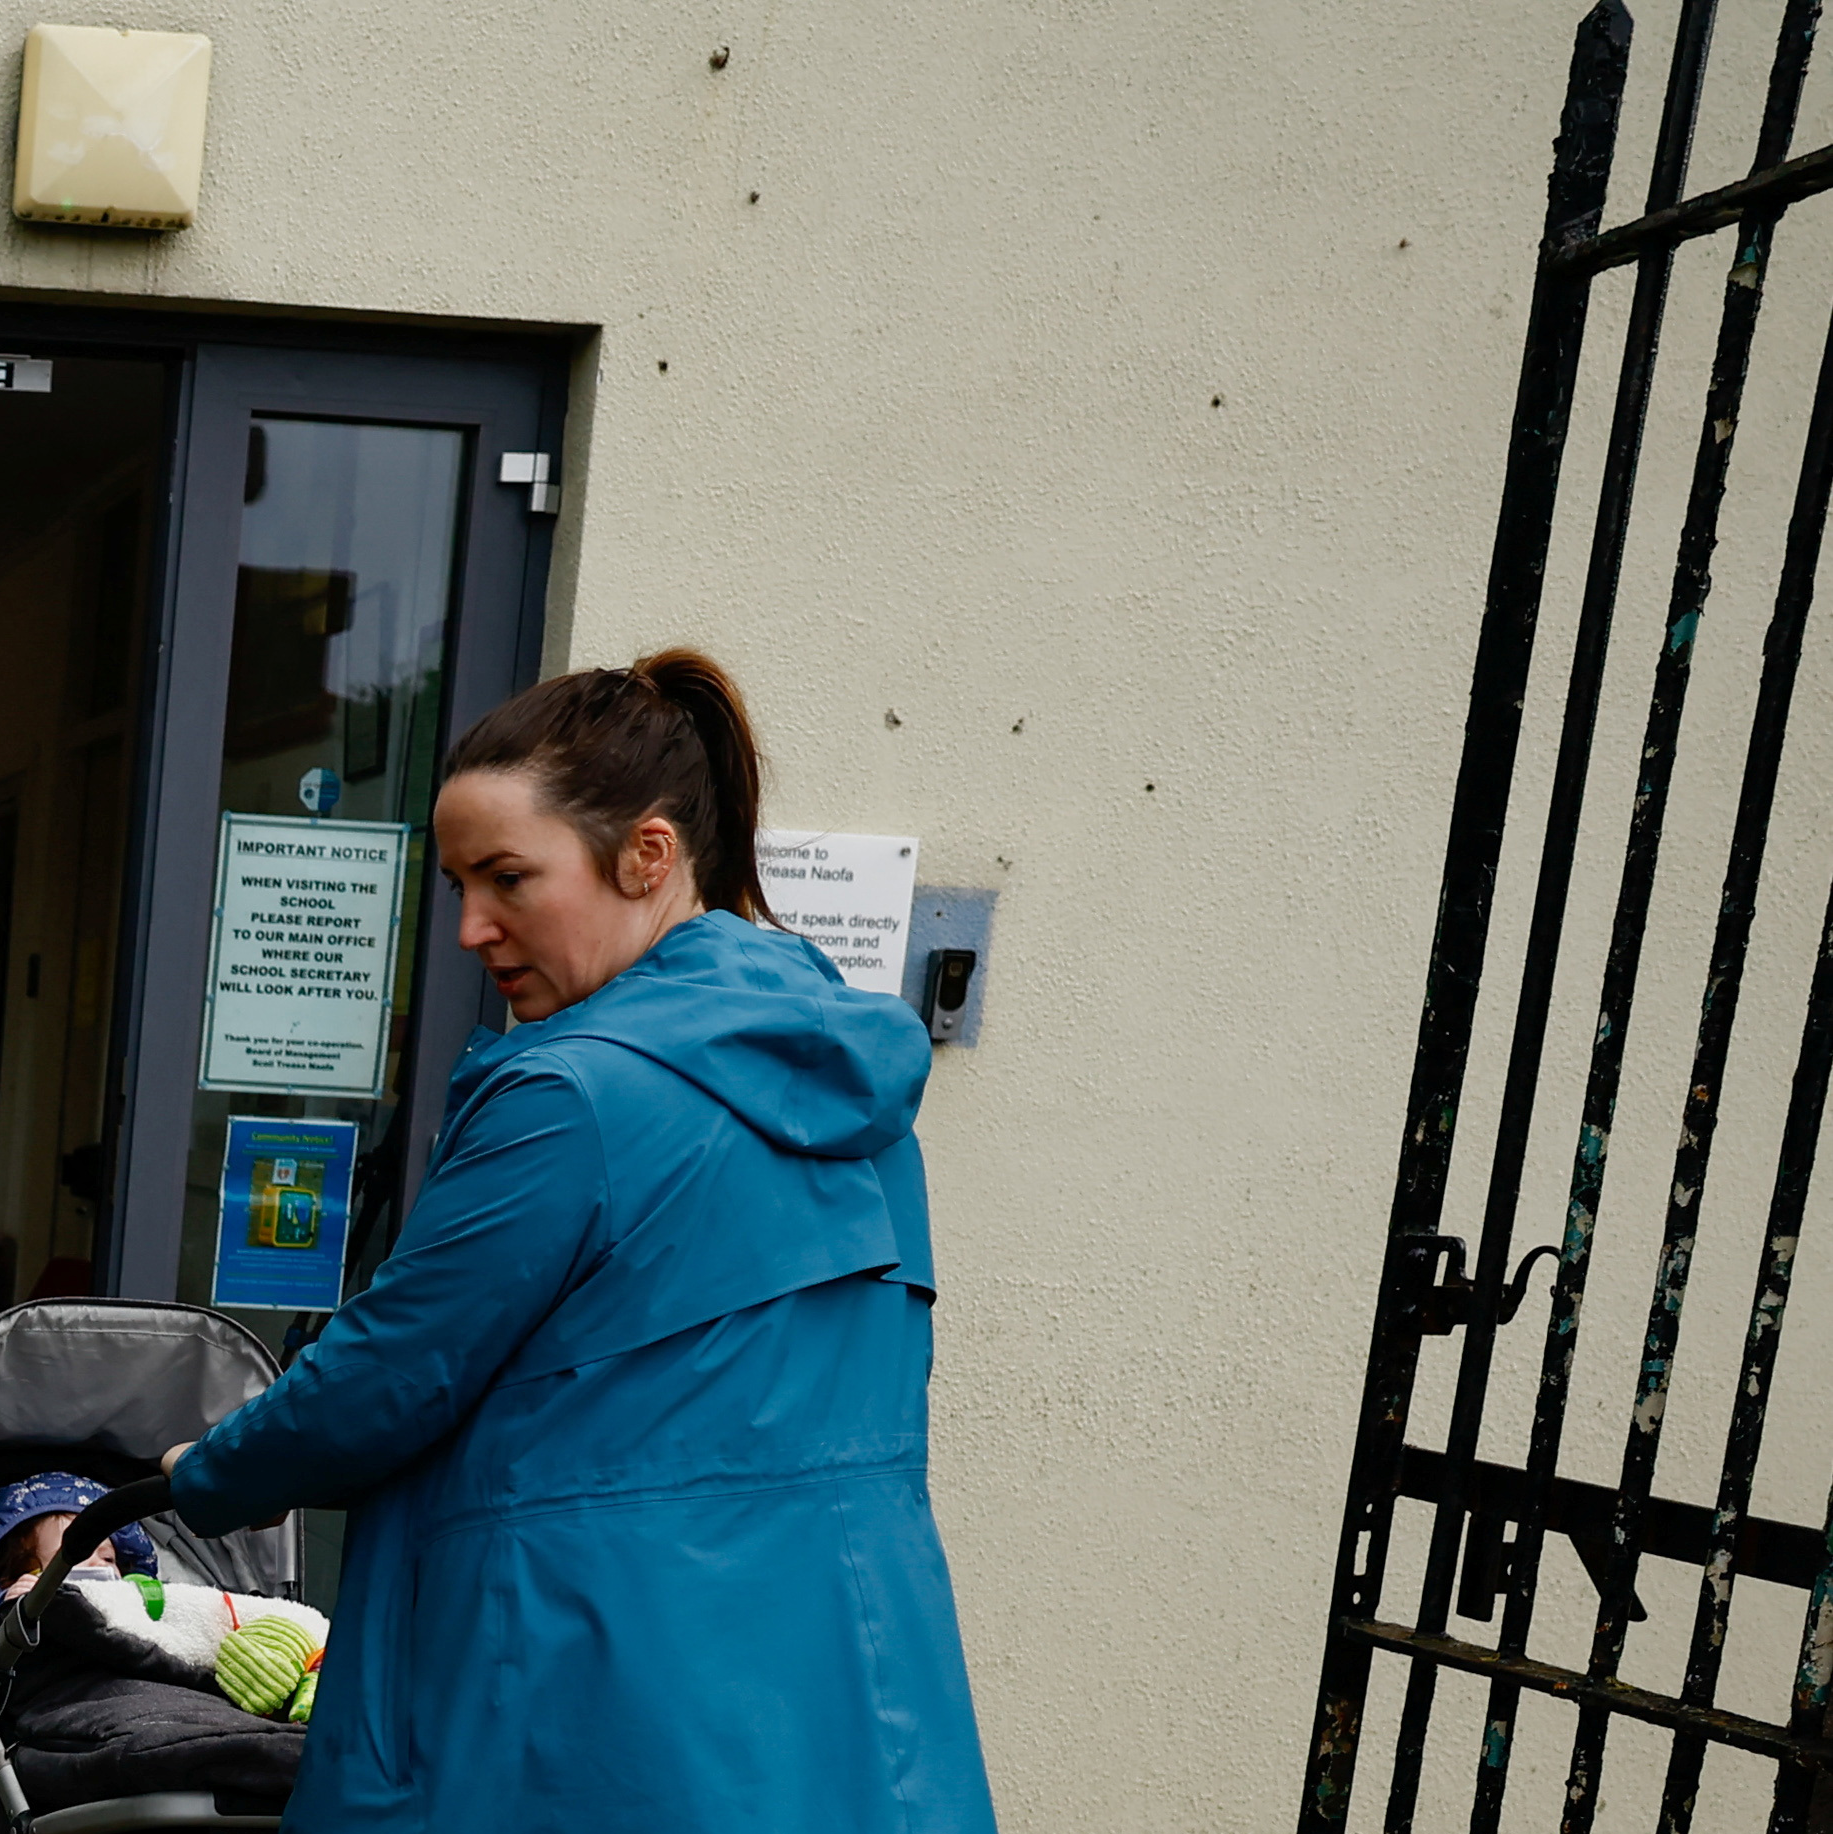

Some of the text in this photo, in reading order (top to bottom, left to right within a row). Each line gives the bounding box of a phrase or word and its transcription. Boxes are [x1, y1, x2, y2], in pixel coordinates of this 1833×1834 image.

[237, 839, 388, 862] IMPORTANT NOTICE
[756, 846, 829, 860] elcome to
[758, 862, 854, 882] Treasa Naofa
[241, 875, 378, 895] WHEN VISITING THE
[279, 896, 336, 910] SCHOOL
[250, 912, 362, 929] PLEASE REPORT
[801, 912, 845, 928] speak
[848, 914, 901, 934] directly
[232, 929, 376, 948] TO OUR MAIN OFFICE
[852, 935, 880, 949] and
[261, 948, 344, 964] WHERE OUR
[832, 954, 887, 970] ception.
[230, 964, 371, 983] SCHOOL SECRETARY
[219, 981, 379, 1002] WILL LOOK AFTER YOU.
[224, 1033, 251, 1044] Thank
[253, 1037, 269, 1045] you
[271, 1036, 284, 1045] for
[285, 1039, 306, 1047] your
[245, 1046, 341, 1060] Board of Management
